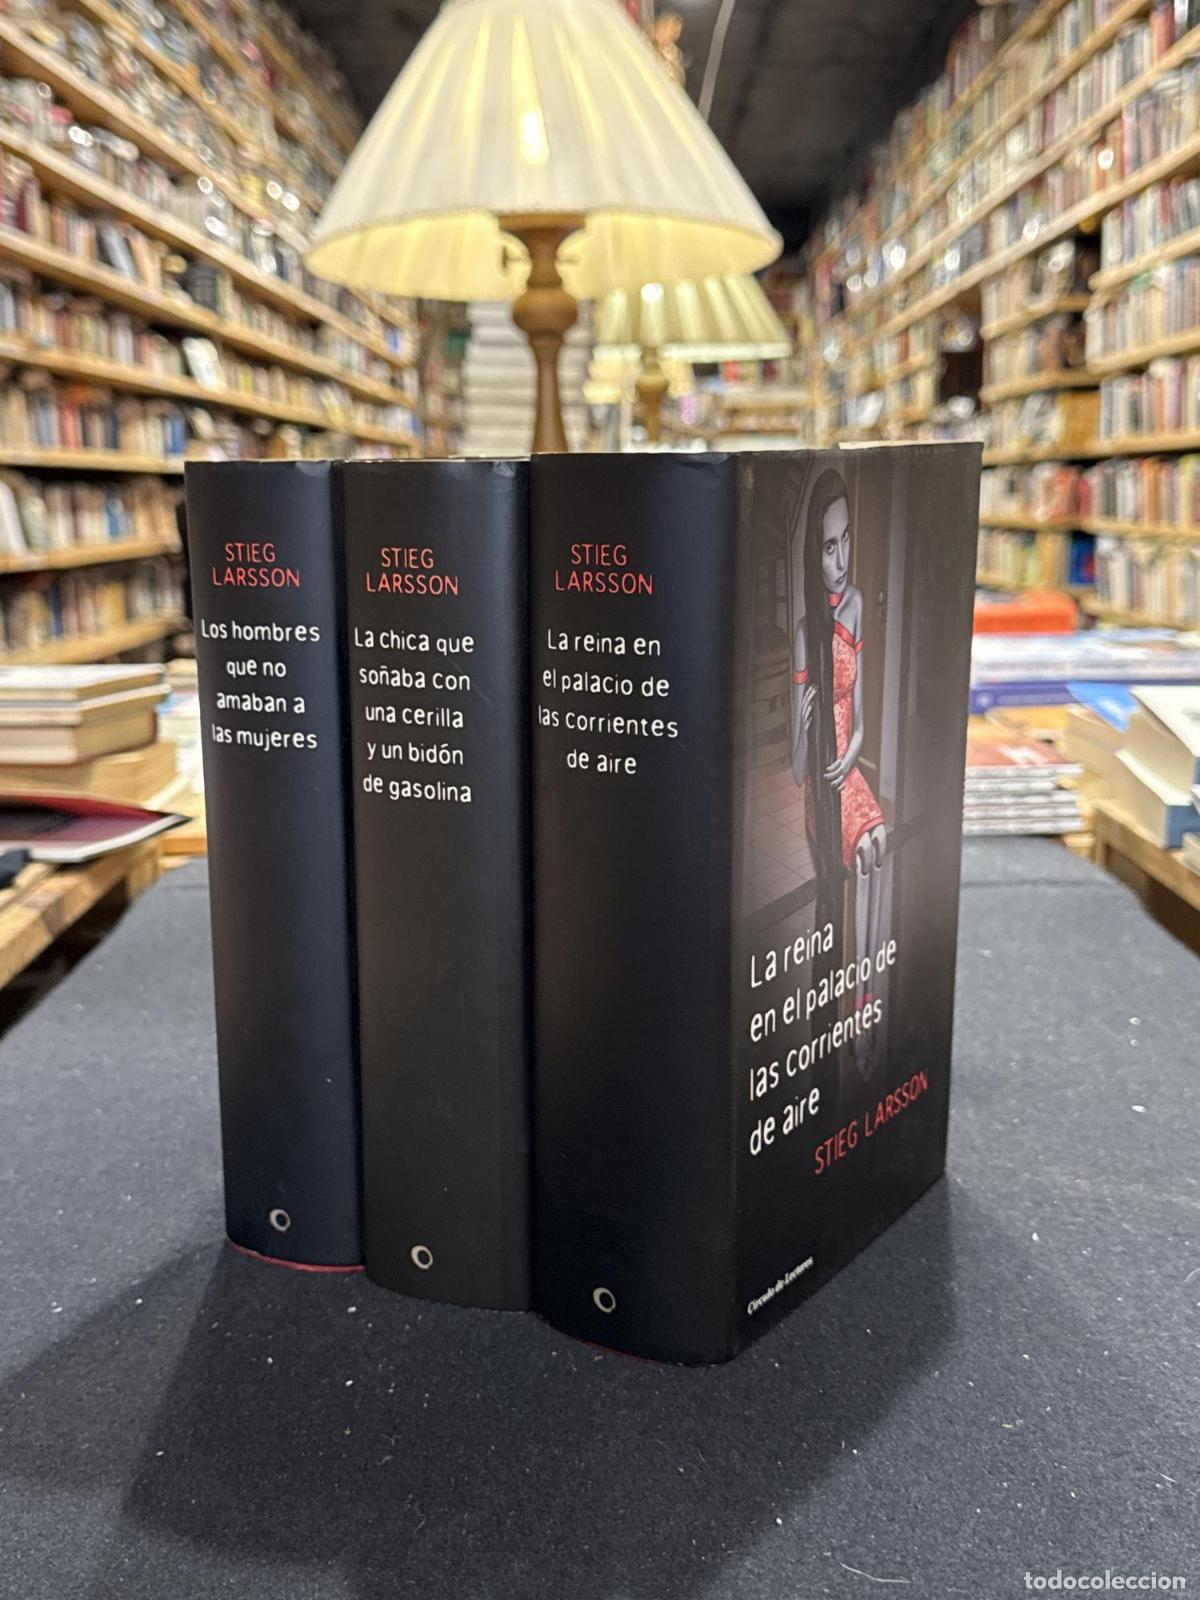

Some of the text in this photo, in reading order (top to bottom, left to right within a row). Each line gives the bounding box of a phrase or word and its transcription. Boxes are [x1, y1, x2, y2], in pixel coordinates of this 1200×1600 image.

[224, 543, 276, 563] STIEG
[381, 548, 434, 569] STIEG
[571, 544, 628, 566] STIEG
[212, 567, 301, 588] LARSSON
[366, 573, 459, 596] LARSSON
[555, 570, 654, 595] LARSSON
[200, 619, 321, 643] Los hombres
[354, 627, 475, 656] La chica que
[547, 628, 662, 656] La reina en
[226, 660, 287, 679] que no
[359, 665, 471, 691] soñaba con
[542, 668, 670, 697] el palacio de
[216, 691, 305, 714] amaban a
[365, 704, 464, 729] una cerilla
[538, 704, 679, 739] las corrientes
[211, 723, 319, 752] las mujeres
[367, 742, 464, 766] y un bidón
[566, 749, 637, 775] de aire
[363, 774, 472, 803] de gasolina
[751, 923, 834, 988] La reina
[750, 939, 897, 1042] en el palacio de
[749, 998, 883, 1102] las corrientes
[750, 1087, 820, 1156] de aire
[814, 1069, 929, 1175] STIEG LARSSON
